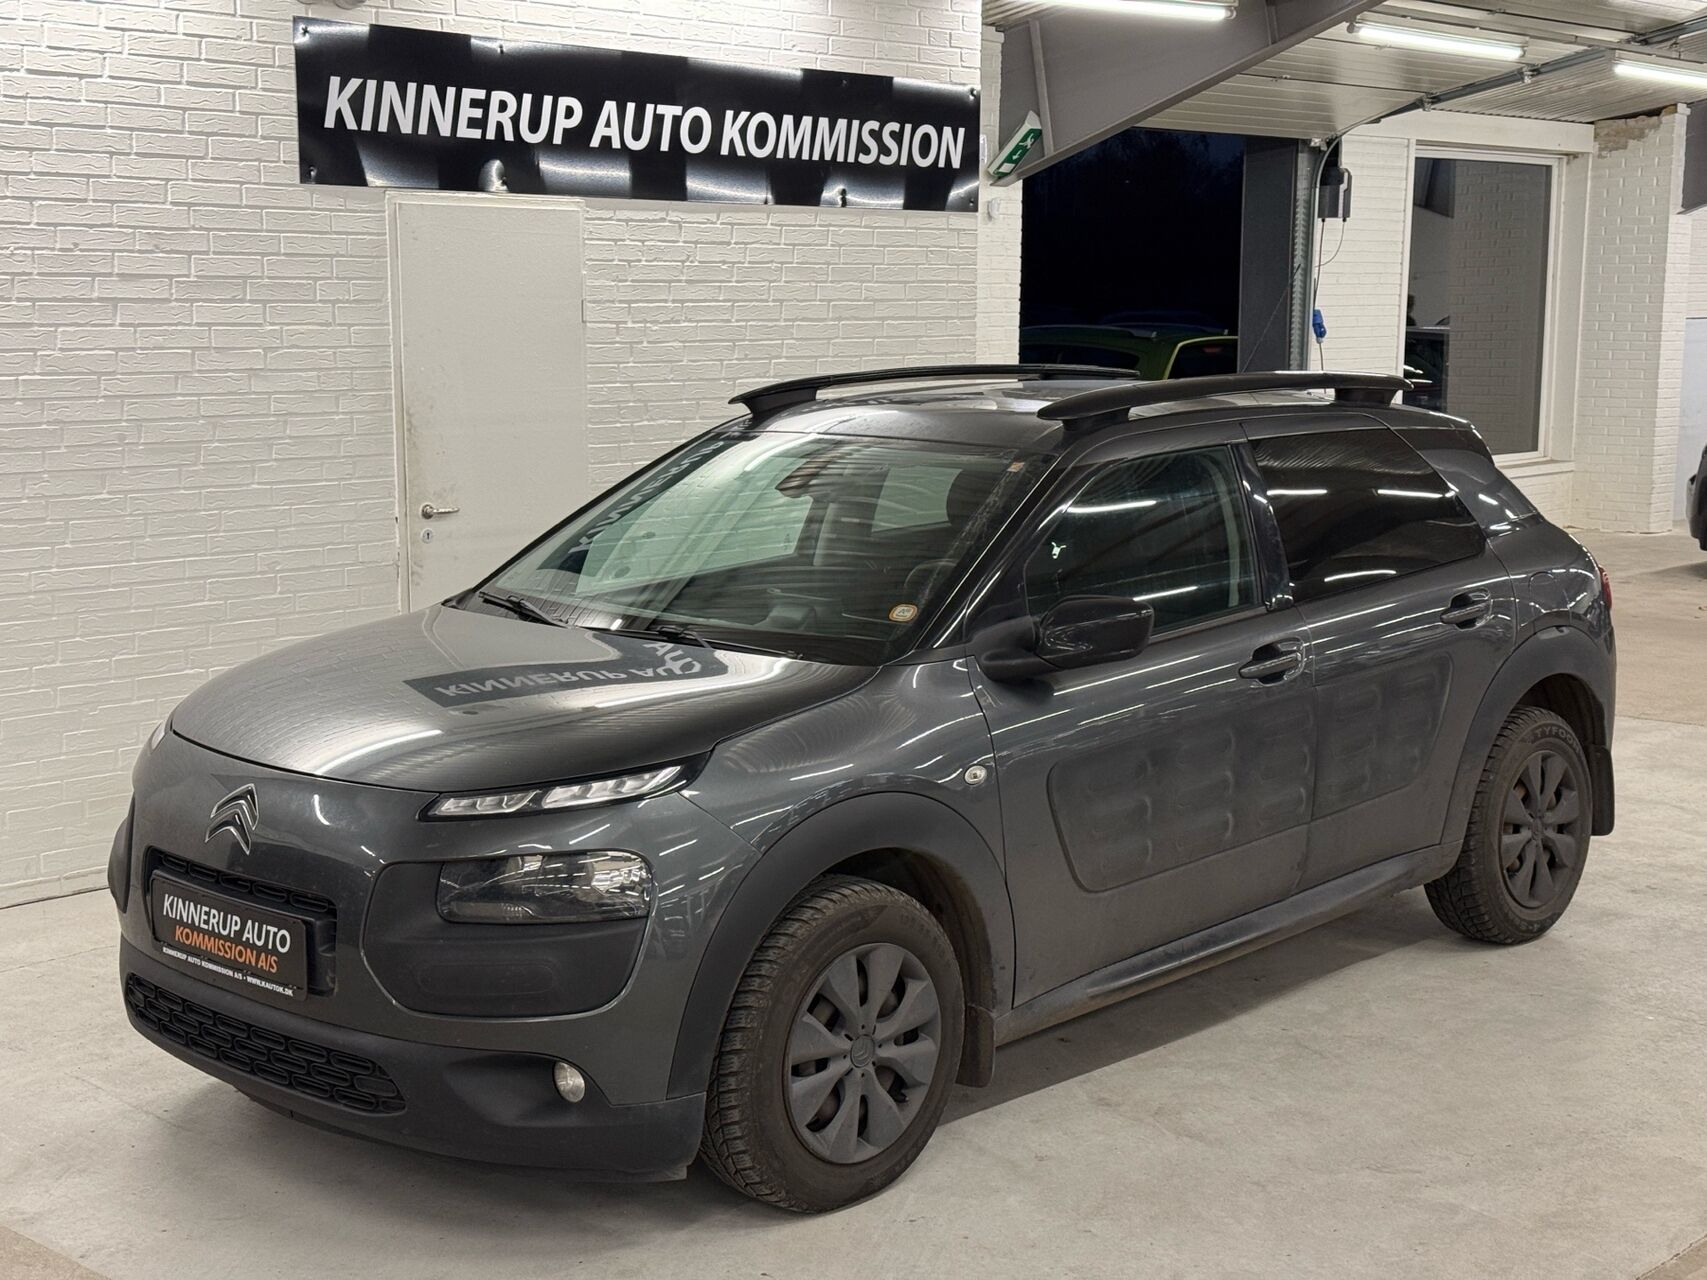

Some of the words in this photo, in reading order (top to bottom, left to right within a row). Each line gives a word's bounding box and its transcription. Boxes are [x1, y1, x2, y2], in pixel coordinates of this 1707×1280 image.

[324, 75, 585, 145] KINNERUP
[590, 99, 713, 155] AUTO
[720, 110, 966, 169] KOMMISSION
[163, 893, 241, 938] KINNERUP
[242, 919, 291, 954] AUTO
[175, 924, 256, 966] KOMMISSION
